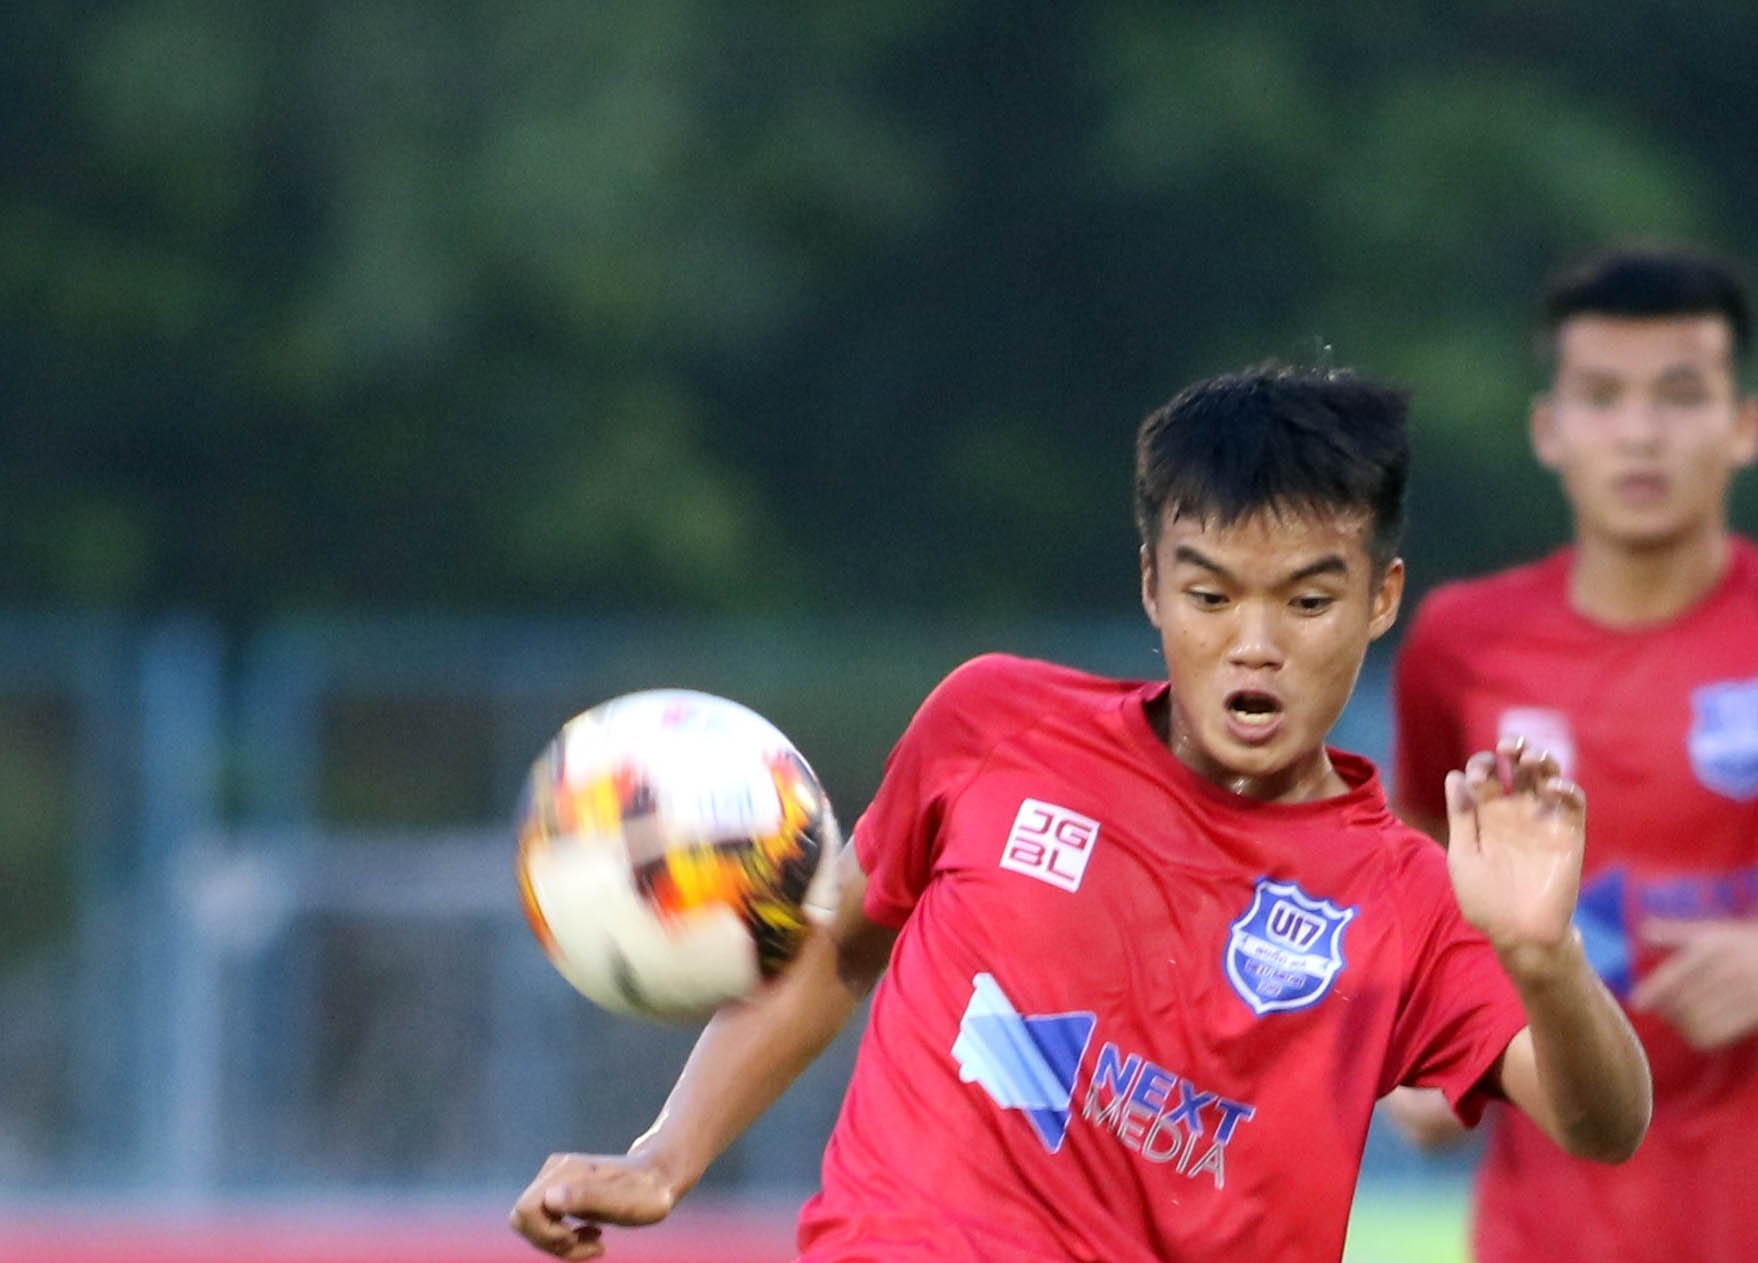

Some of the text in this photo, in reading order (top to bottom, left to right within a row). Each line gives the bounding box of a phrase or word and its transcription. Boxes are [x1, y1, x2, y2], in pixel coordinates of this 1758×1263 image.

[1270, 905, 1323, 948] U17
[1082, 1083, 1227, 1190] MEDIA
[1093, 1041, 1257, 1145] NEXT
